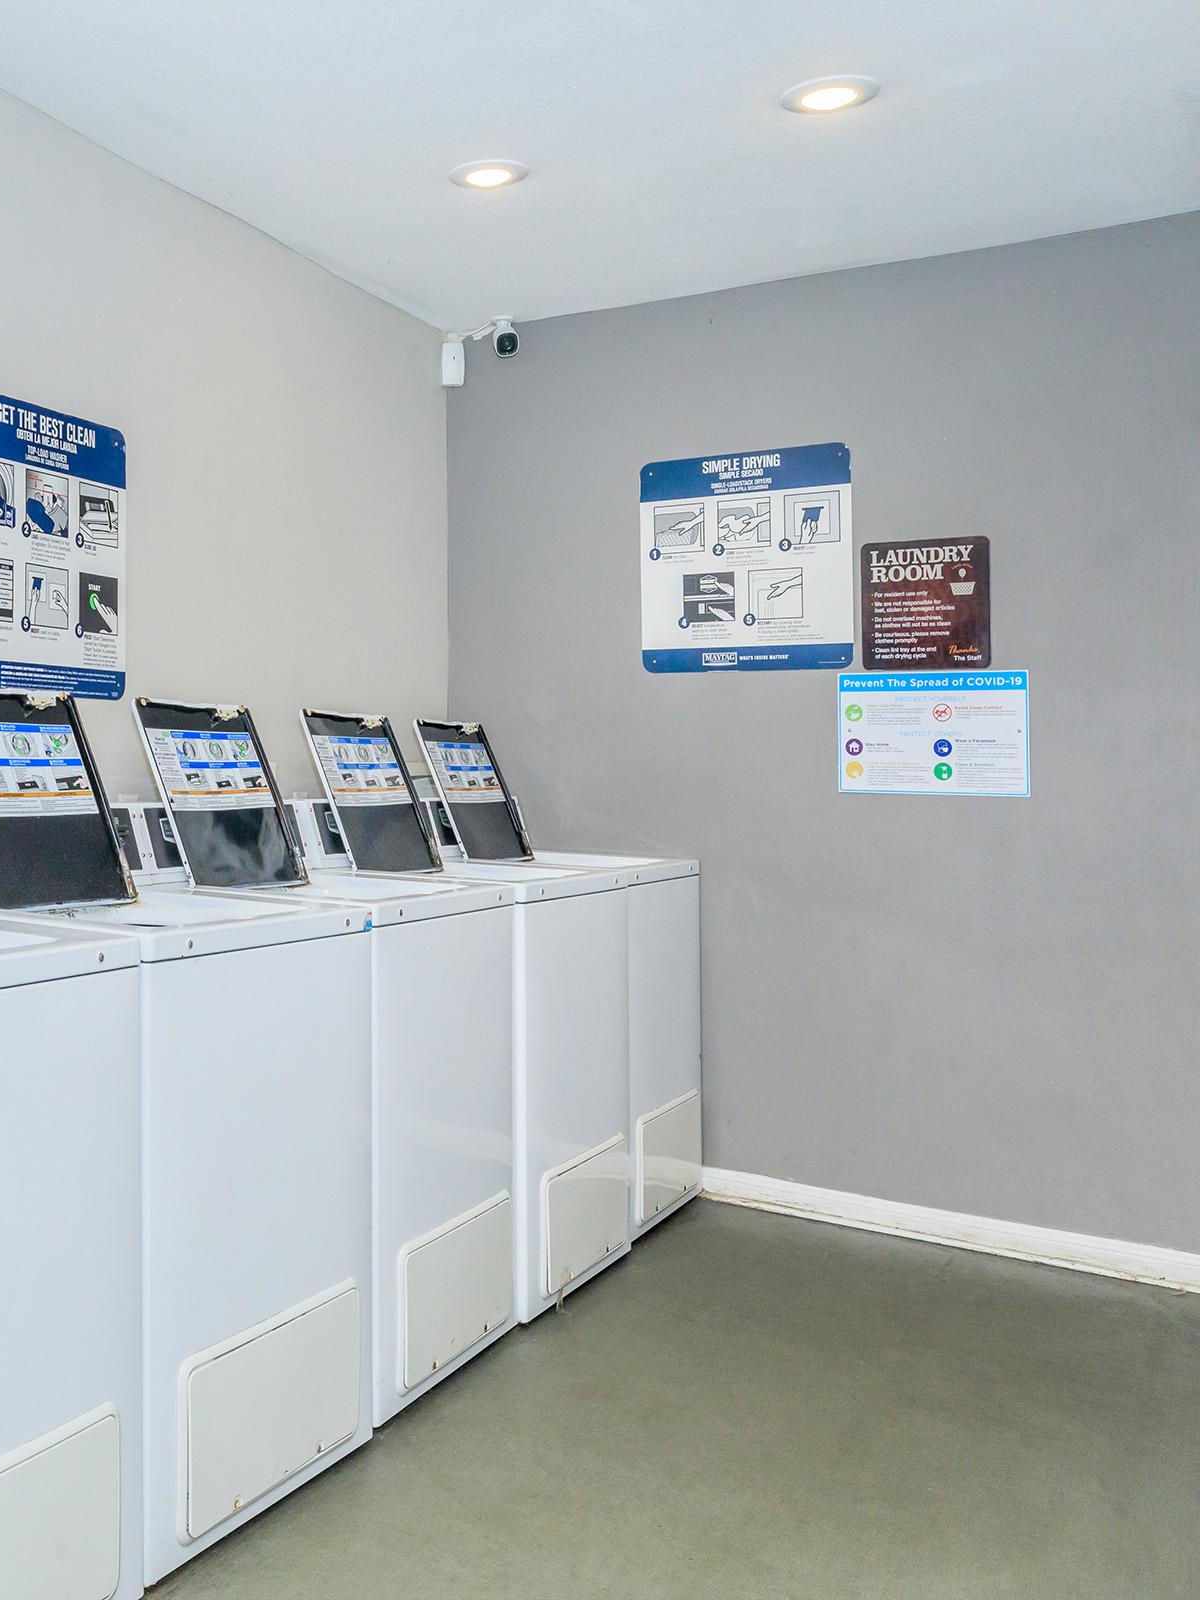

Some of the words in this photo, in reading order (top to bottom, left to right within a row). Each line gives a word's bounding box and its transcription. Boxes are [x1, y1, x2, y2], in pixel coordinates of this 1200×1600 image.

[17, 408, 37, 432] THE
[40, 415, 64, 439] BEST
[66, 422, 96, 448] CLEAN
[702, 458, 740, 474] SIMPLE
[742, 454, 780, 470] DRYING
[718, 470, 740, 480] SIMPLE
[740, 468, 764, 478] SECADO
[24, 523, 29, 534] 2
[78, 535, 82, 545] 3
[782, 540, 788, 550] 3
[716, 544, 722, 554] 2
[652, 550, 658, 560] 1
[870, 545, 974, 566] LAUNDRY
[870, 564, 944, 583] ROOM
[88, 584, 102, 592] START
[23, 618, 28, 629] 5
[681, 618, 687, 627] 4
[746, 615, 752, 624] 5
[77, 626, 82, 634] 6
[843, 679, 884, 688] Prevent
[887, 678, 906, 688] The
[910, 678, 949, 688] Spread
[952, 677, 964, 686] of
[966, 676, 1023, 686] COVID-19
